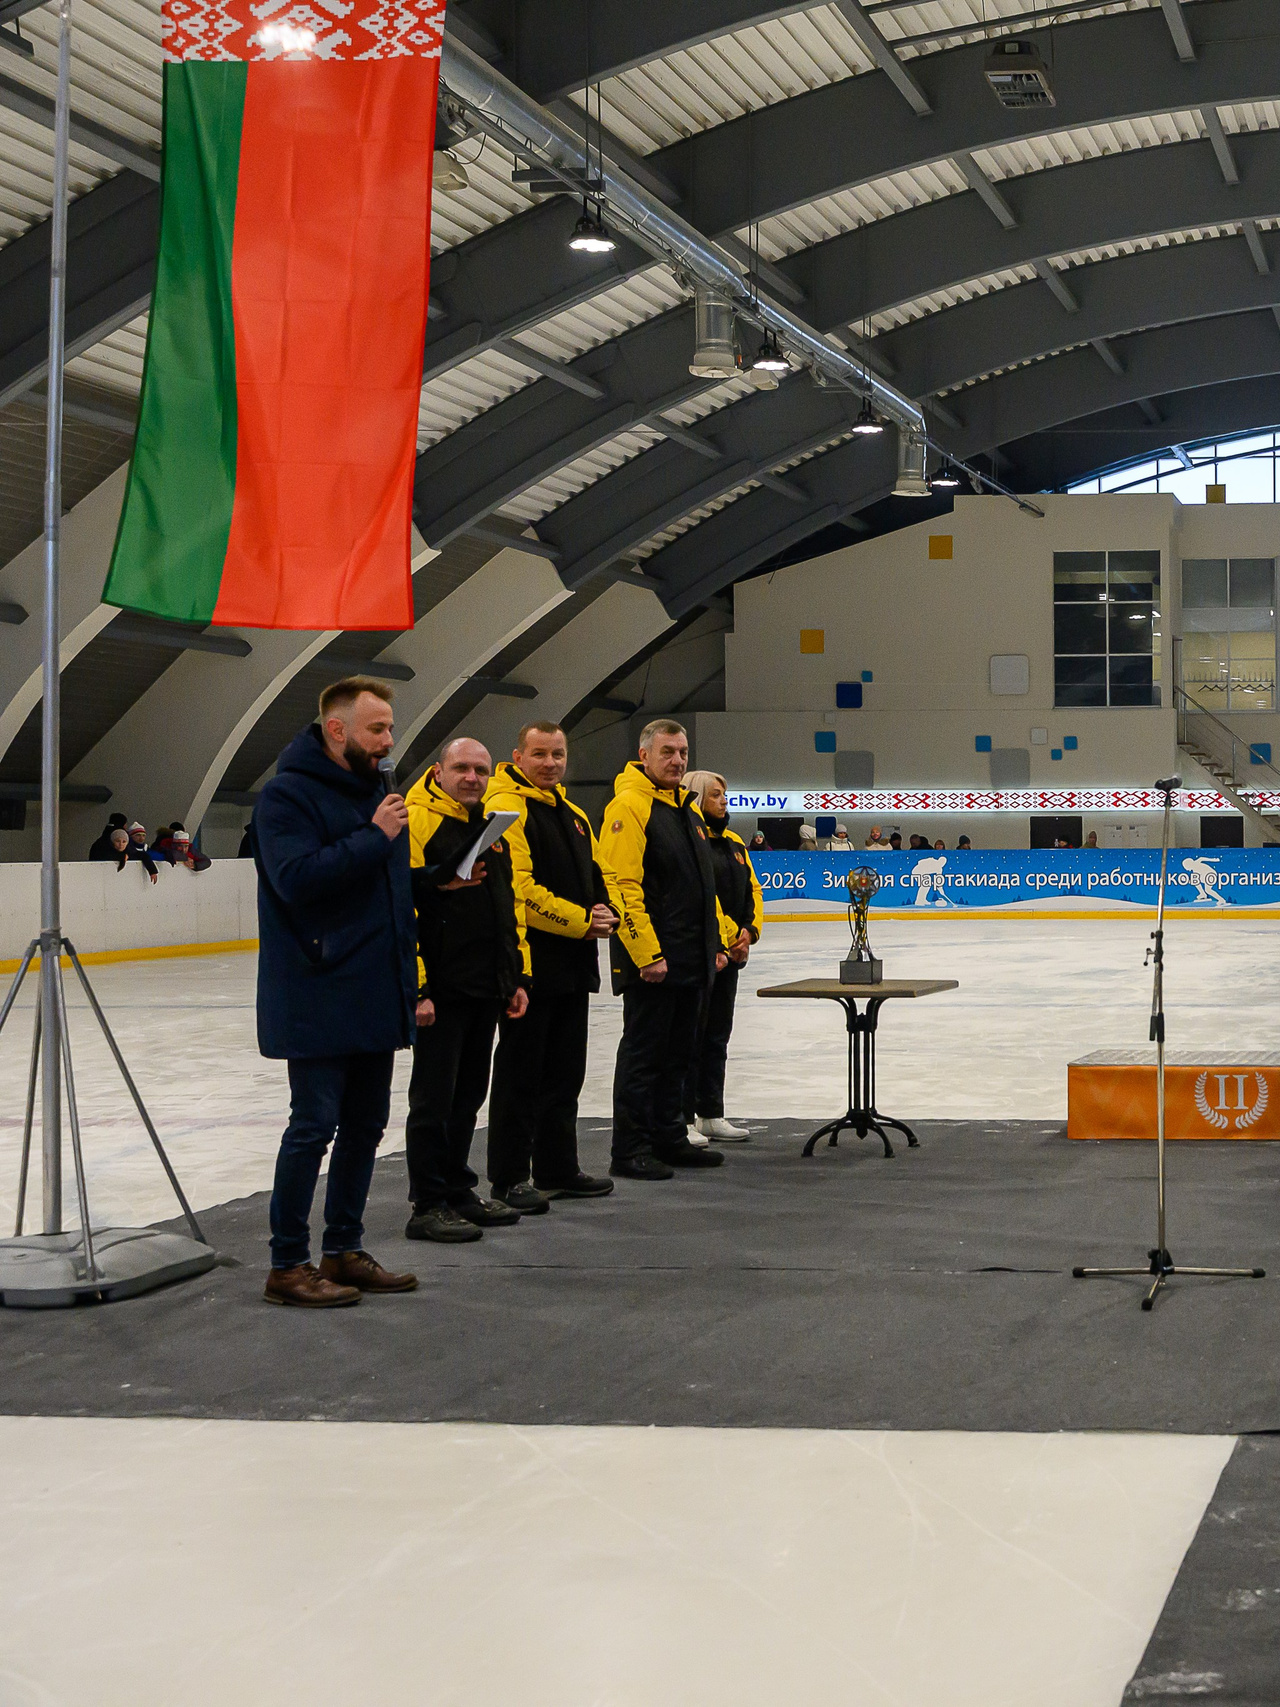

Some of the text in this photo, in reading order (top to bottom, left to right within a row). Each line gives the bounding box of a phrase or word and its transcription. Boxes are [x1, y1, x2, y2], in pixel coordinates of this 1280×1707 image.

[761, 871, 806, 889] 2026
[900, 873, 1020, 891] спартакиада
[1025, 873, 1082, 891] среди
[525, 898, 570, 927] BELARUS
[1213, 1074, 1249, 1110] II
